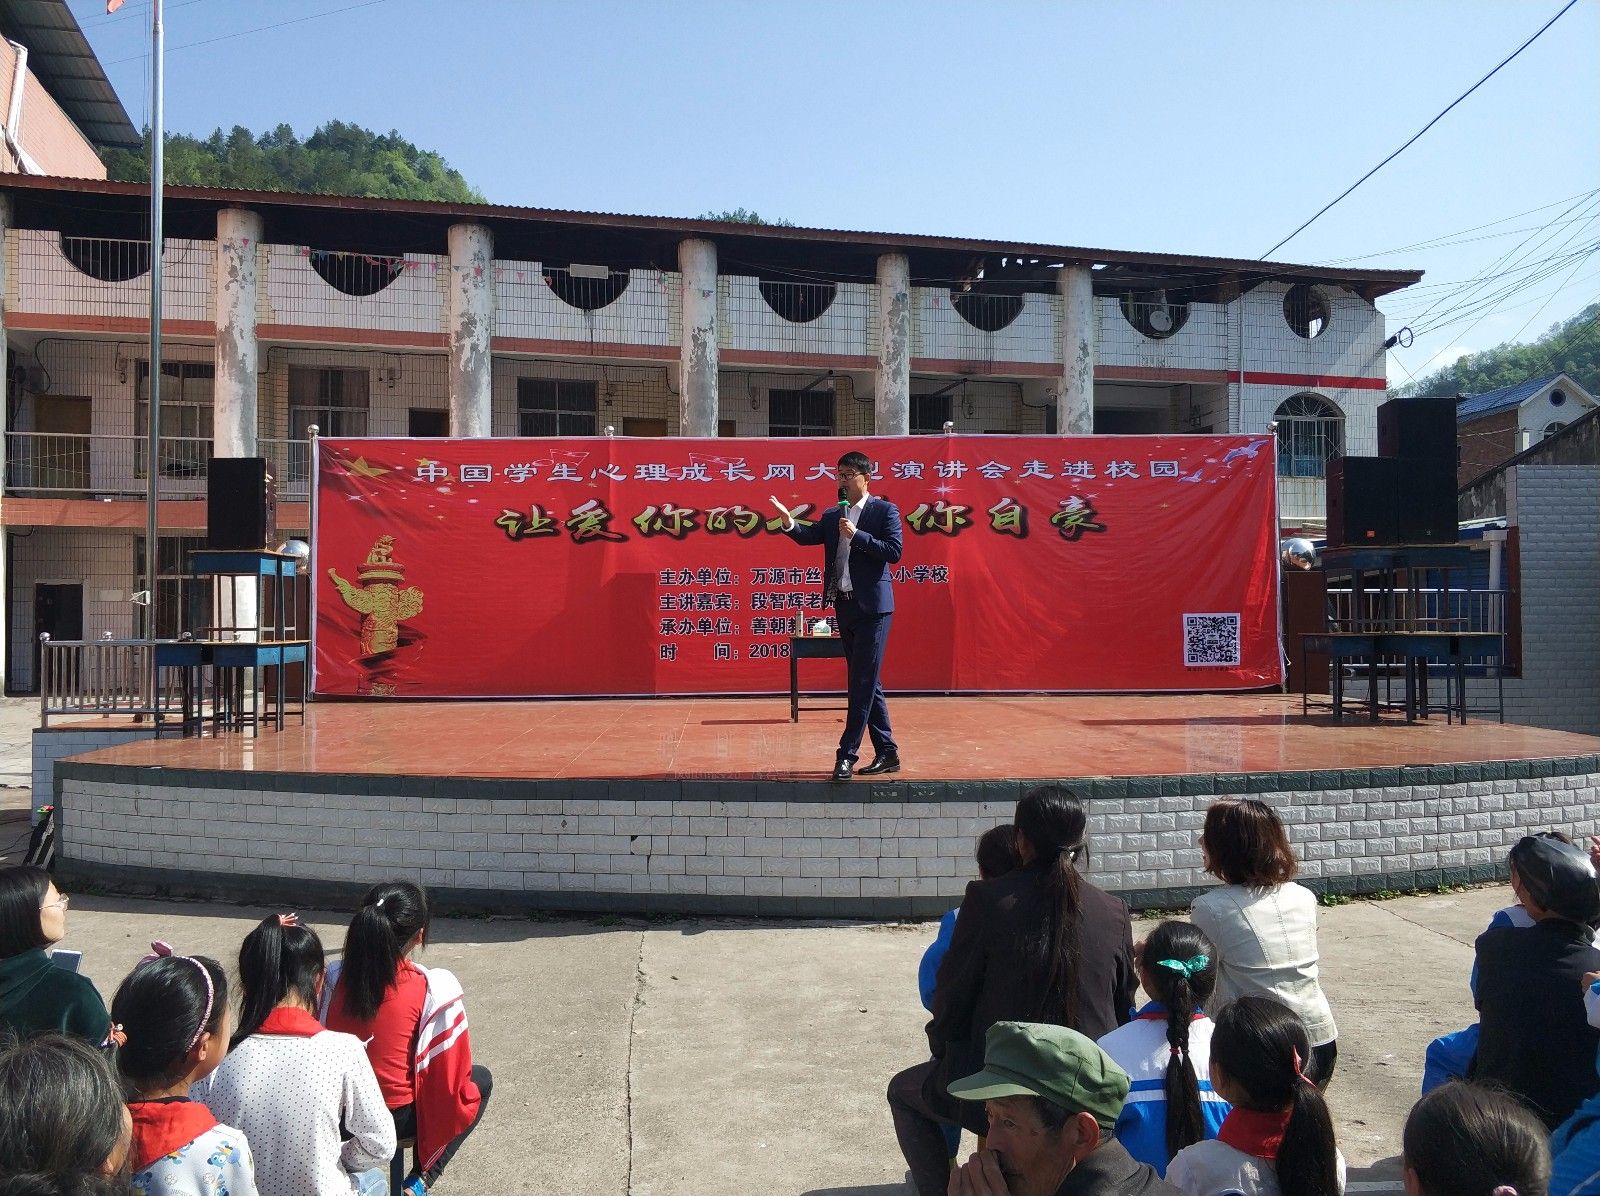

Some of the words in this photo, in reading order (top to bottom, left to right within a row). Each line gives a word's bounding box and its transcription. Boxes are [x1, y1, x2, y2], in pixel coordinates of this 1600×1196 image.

[659, 567, 739, 586] 主办单位：
[659, 592, 739, 611] 主讲嘉宾：
[659, 617, 740, 636] 承办单位：
